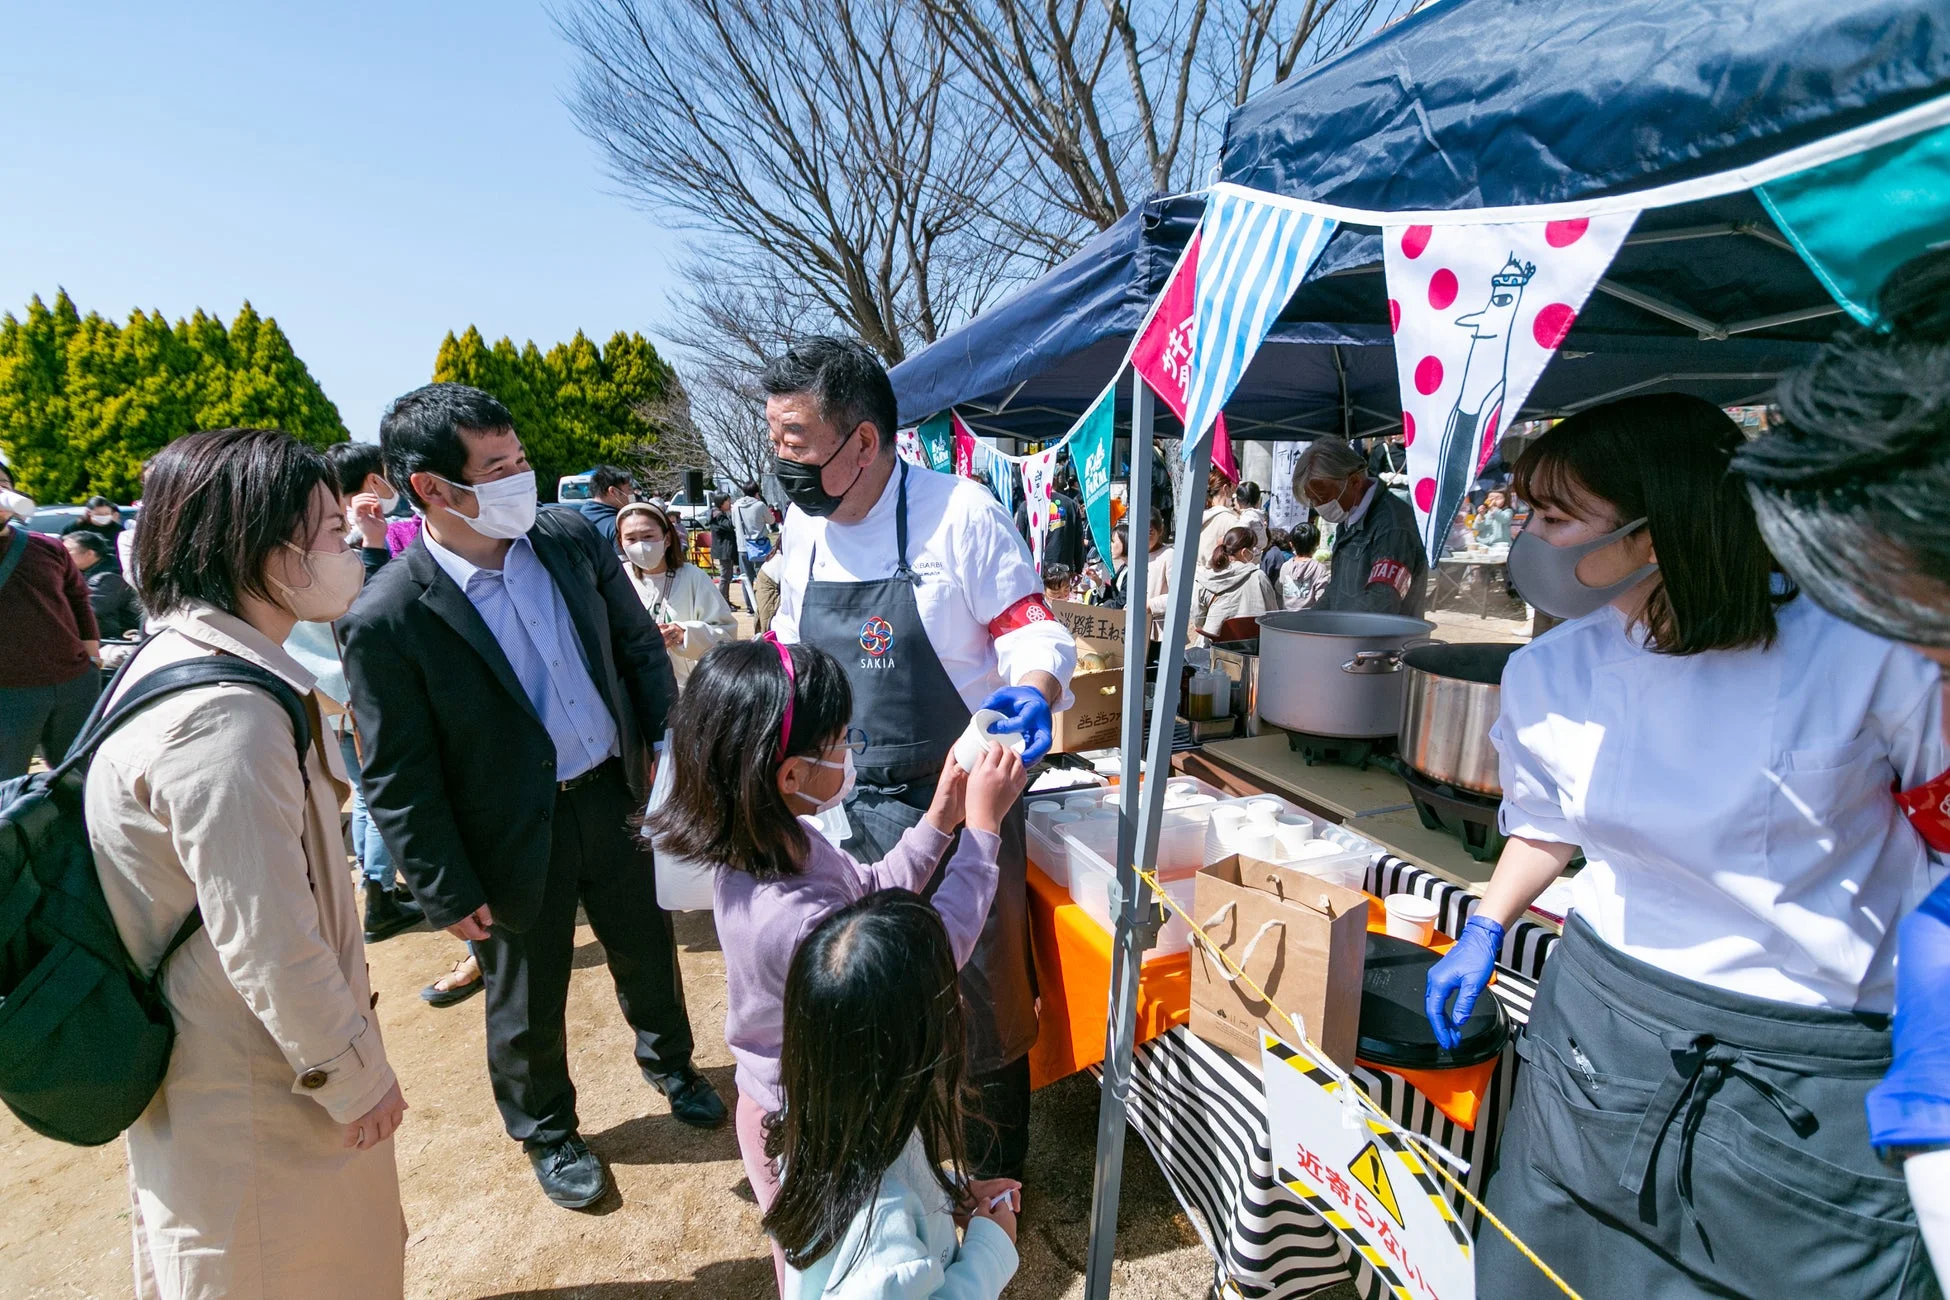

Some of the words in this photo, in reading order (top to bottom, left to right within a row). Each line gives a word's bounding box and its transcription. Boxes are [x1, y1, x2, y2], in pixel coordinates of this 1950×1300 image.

[860, 657, 896, 669] SAKIA
[1296, 1142, 1440, 1300] 近寄らない
